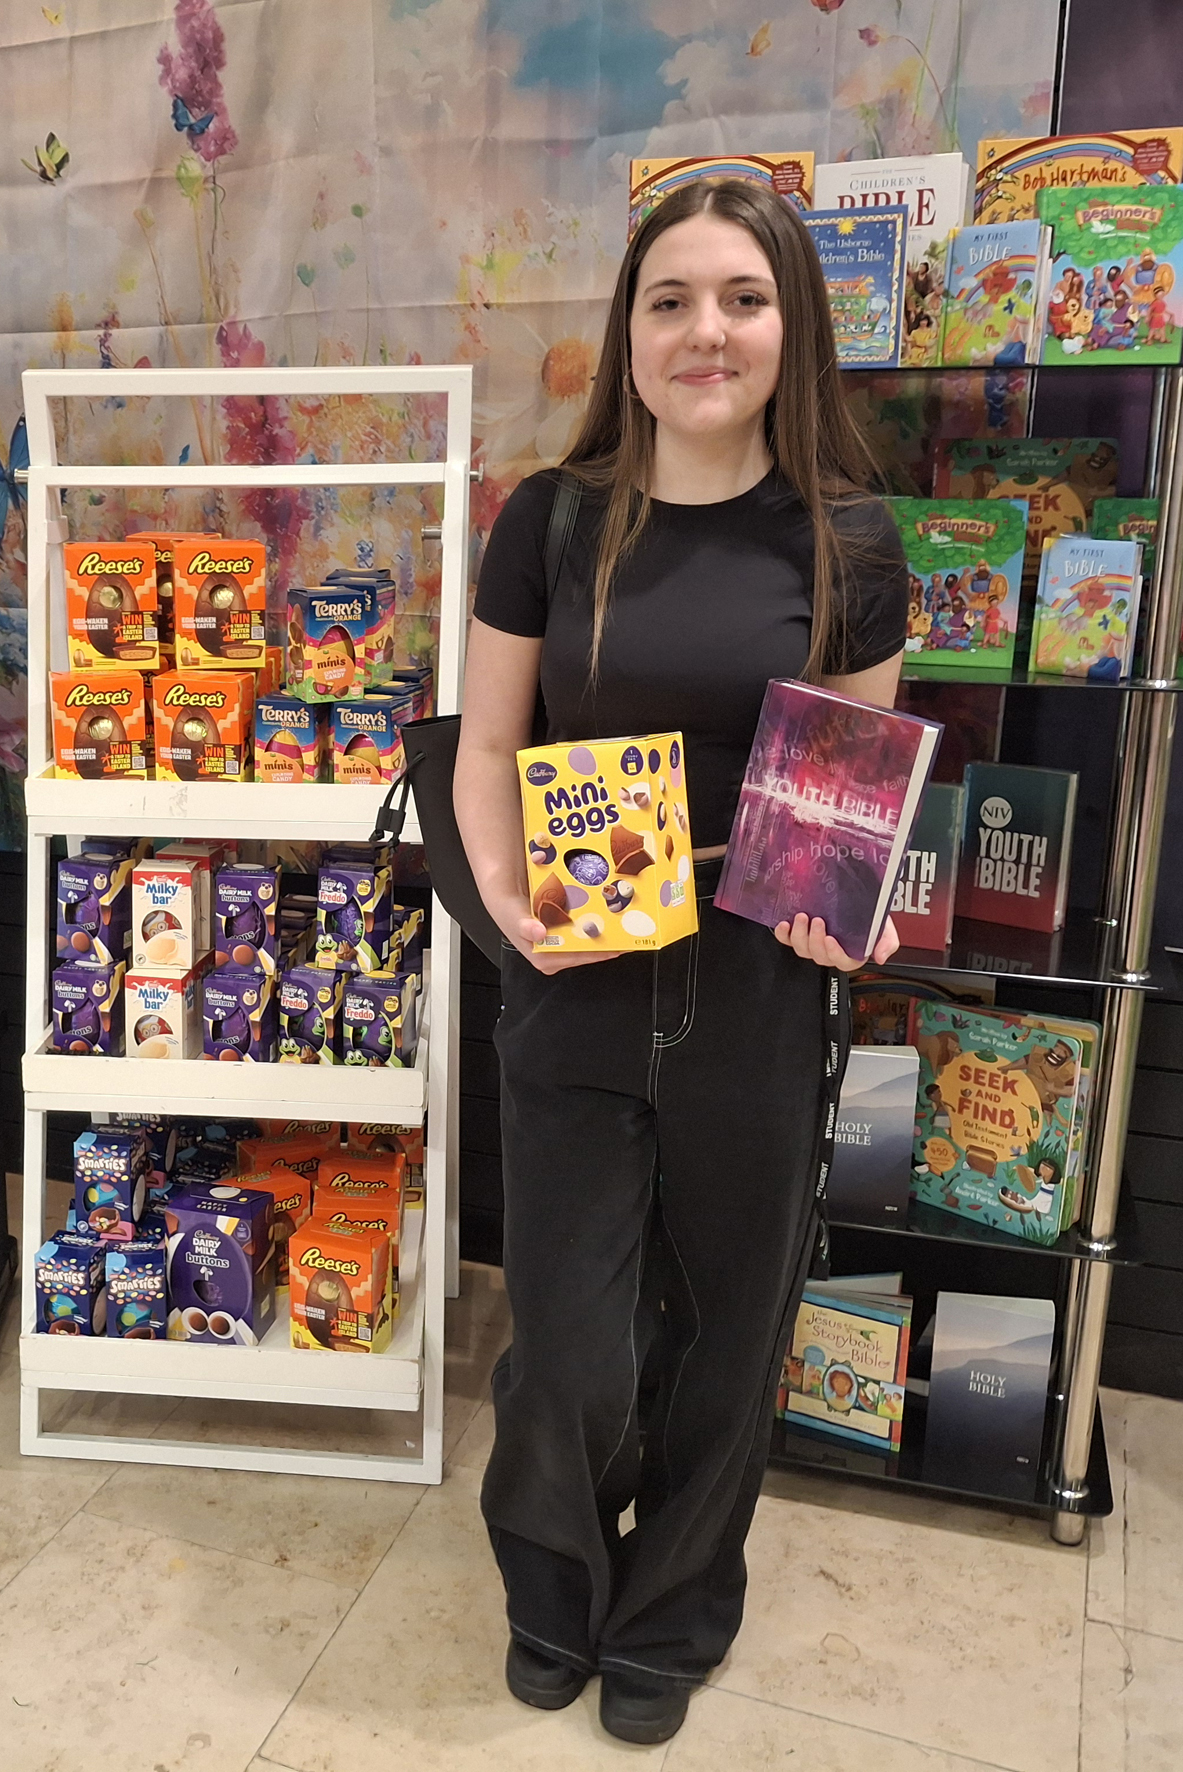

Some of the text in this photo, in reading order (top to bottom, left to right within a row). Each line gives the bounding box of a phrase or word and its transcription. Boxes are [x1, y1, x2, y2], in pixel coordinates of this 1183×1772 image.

[849, 176, 926, 191] CHILDREN'S
[1023, 164, 1128, 191] Bob Hartman's
[1083, 207, 1157, 222] Beginner's
[819, 239, 872, 249] The Usborne
[858, 249, 885, 262] Bible
[969, 243, 1012, 266] BIBLE
[922, 520, 991, 535] Beginner's
[78, 553, 142, 574] Reese's
[188, 552, 252, 574] Reese's
[1064, 560, 1109, 577] BIBLE
[311, 599, 362, 617] TERRY'S
[122, 614, 142, 624] WIN
[230, 614, 250, 623] WIN
[317, 656, 346, 670] minis
[325, 672, 345, 680] CANDY
[66, 685, 131, 706] Reese's
[164, 685, 225, 707] Reese's
[258, 705, 310, 722] TERRY'S
[337, 708, 387, 726] TERRY'S
[110, 744, 130, 754] WIN
[204, 746, 224, 757] WIN
[784, 744, 825, 766] love
[264, 760, 293, 771] minis
[343, 764, 371, 775] minis
[527, 767, 556, 778] Cadbury
[883, 776, 910, 792] faith
[544, 775, 608, 815] Mini
[764, 774, 836, 808] YOUTH
[842, 797, 900, 828] BIBLE
[548, 804, 620, 838] eggs
[982, 806, 1011, 820] NIV
[810, 841, 865, 862] hope
[978, 827, 1048, 866] YOUTH
[979, 858, 1043, 898] BIBLE
[62, 882, 86, 891] buttons
[146, 883, 178, 895] Milky
[152, 894, 172, 904] bar
[320, 892, 346, 903] Freddo
[891, 881, 932, 915] BLE
[58, 991, 84, 999] buttons
[138, 988, 169, 1001] Milky
[208, 998, 235, 1007] buttons
[830, 977, 839, 1016] STUDENT
[144, 998, 163, 1009] bar
[282, 997, 307, 1009] Freddo
[346, 1009, 374, 1019] Freddo
[968, 1032, 991, 1045] Sarah
[992, 1038, 1018, 1051] Parker
[831, 1041, 839, 1074] TUDENT
[959, 1064, 1019, 1096] SEEK
[975, 1089, 1001, 1103] AND
[957, 1096, 1015, 1129] FIND
[825, 1102, 835, 1140] STUDENT
[835, 1121, 872, 1134] HOLY
[963, 1120, 974, 1129] Old
[834, 1132, 872, 1146] BIBLE
[980, 1135, 1005, 1149] Stories
[78, 1157, 126, 1171] SMARTIES
[816, 1162, 830, 1198] STUDENT
[274, 1194, 302, 1213] ese's
[192, 1238, 221, 1248] DAIRY
[195, 1246, 217, 1256] MILK
[186, 1252, 229, 1268] buttons
[300, 1248, 360, 1275] Reese's
[38, 1269, 85, 1285] SMARTIES
[110, 1276, 161, 1294] SMARTIES
[338, 1311, 357, 1322] WIN
[806, 1312, 842, 1329] Jesus
[812, 1325, 883, 1353] Storybook
[851, 1349, 891, 1368] Bible
[970, 1370, 1006, 1386] HOLY
[969, 1382, 1006, 1398] BIBLE
